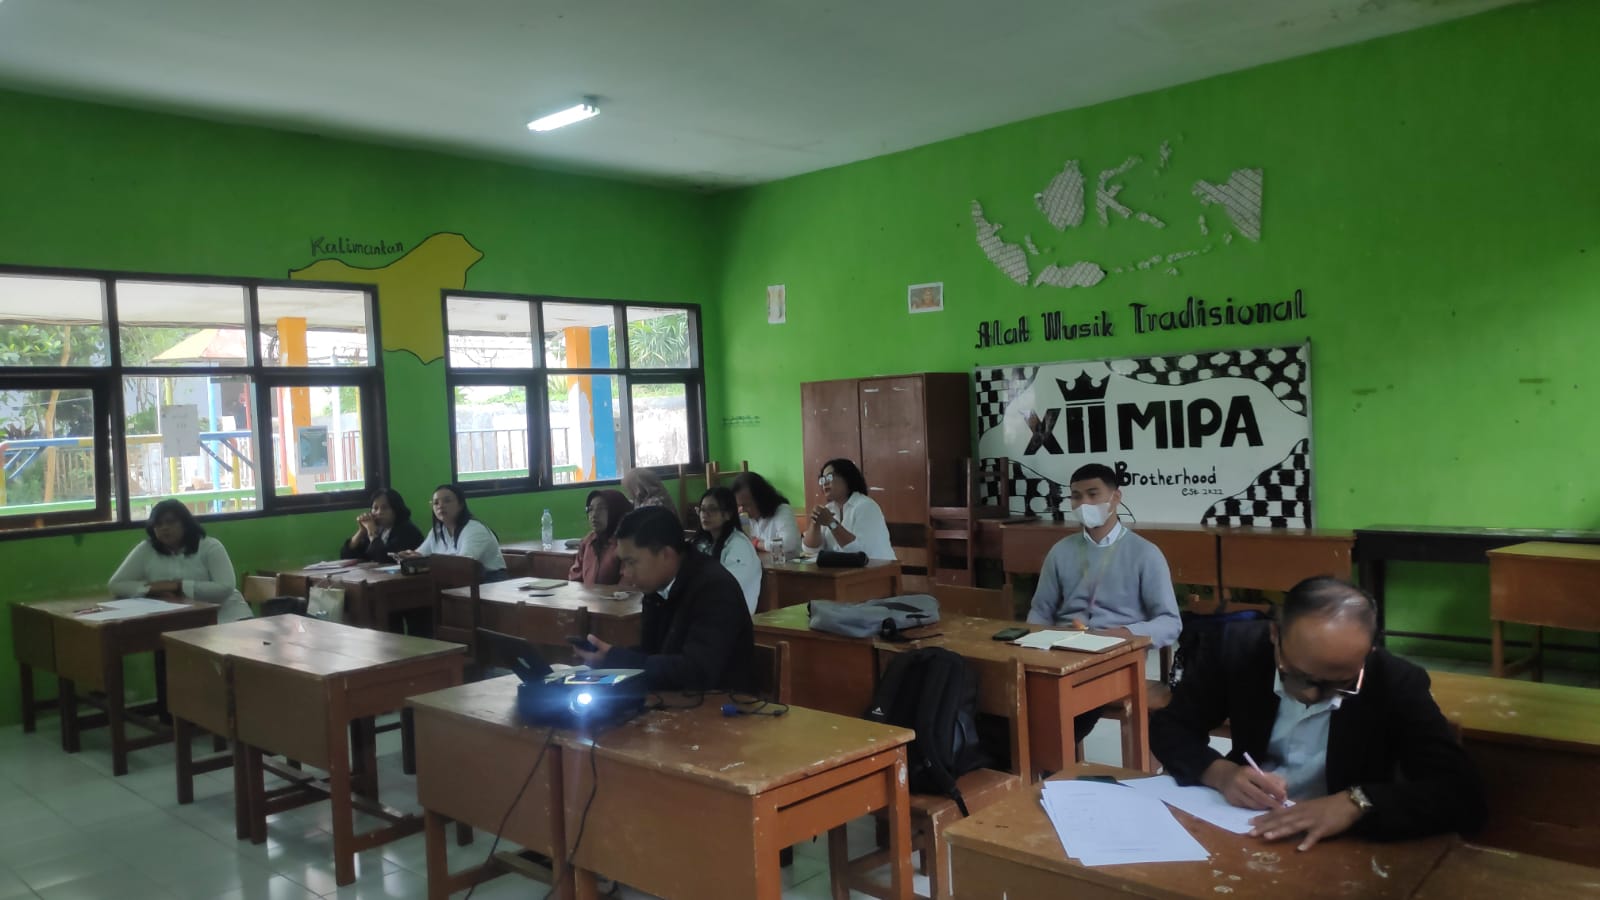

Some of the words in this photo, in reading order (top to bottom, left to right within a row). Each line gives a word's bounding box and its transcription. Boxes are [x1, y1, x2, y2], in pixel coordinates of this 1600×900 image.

[974, 316, 1031, 349] Alat
[1041, 310, 1114, 341] Musik
[1129, 288, 1307, 334] Tradisional
[1021, 403, 1108, 456] XII
[1117, 395, 1264, 451] MIPA
[1114, 461, 1217, 487] Brotherhood
